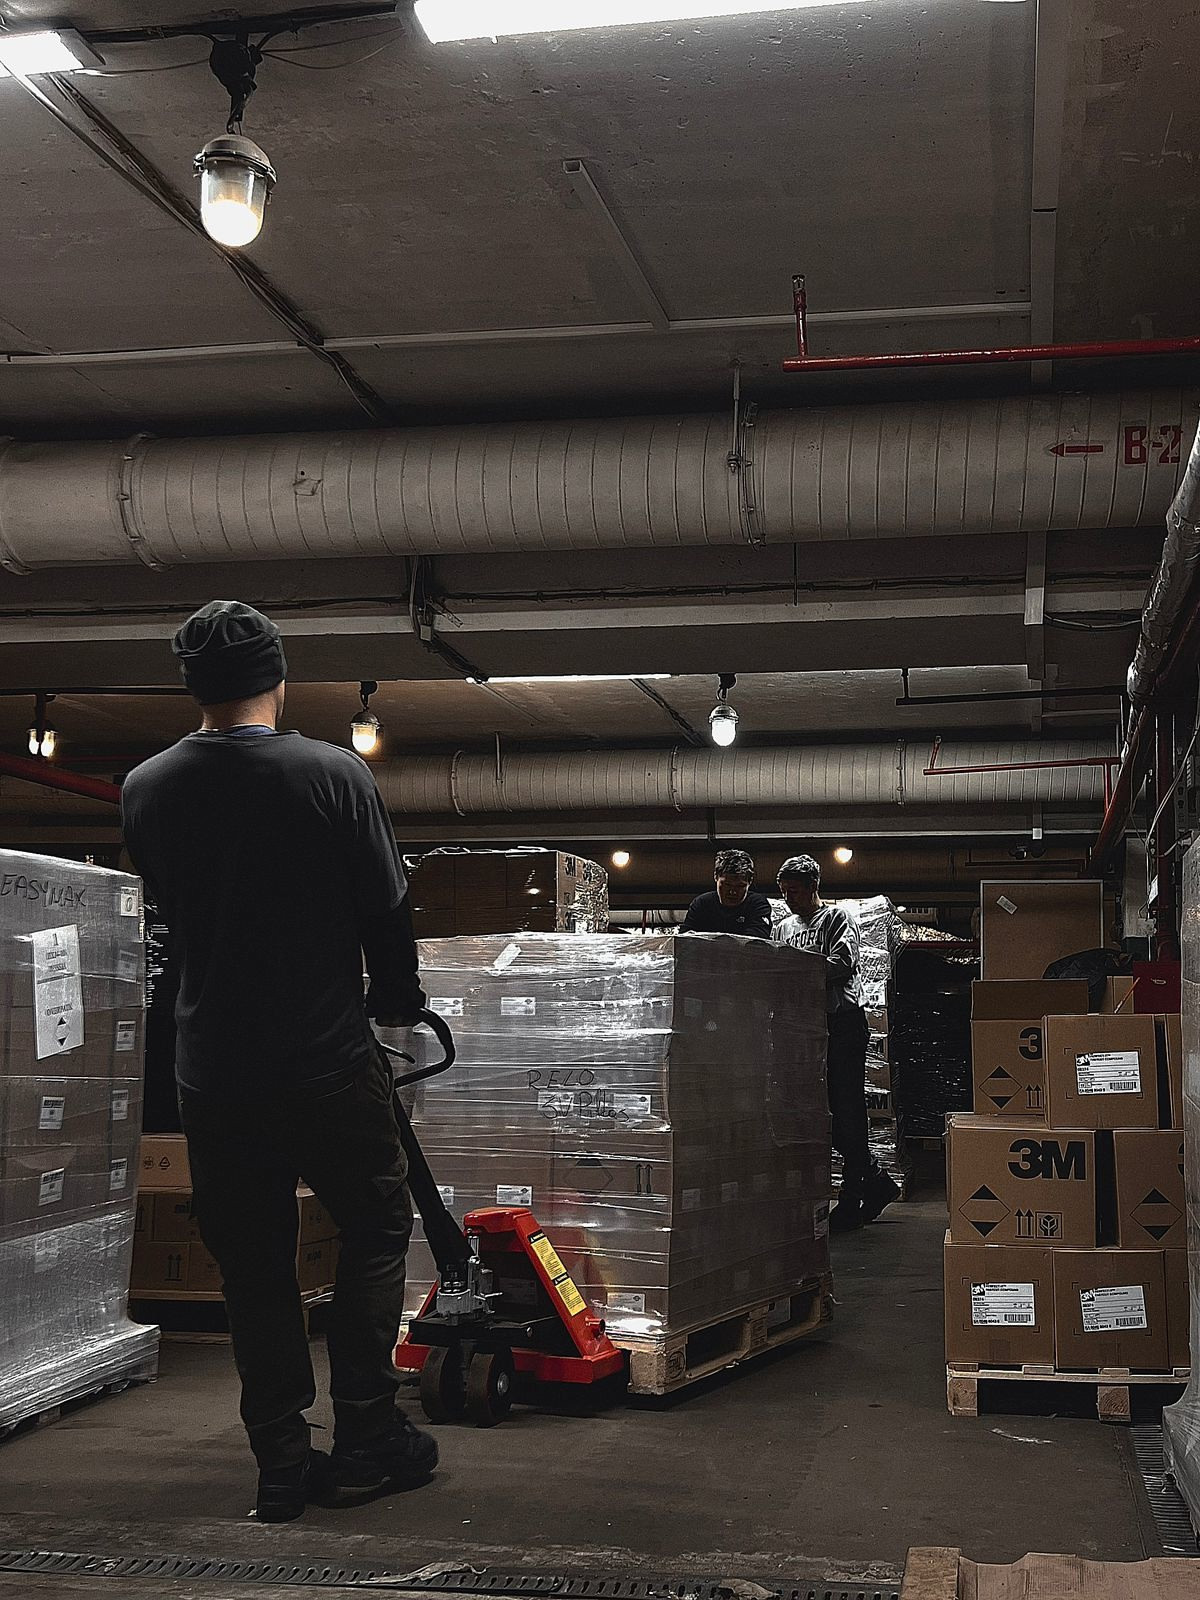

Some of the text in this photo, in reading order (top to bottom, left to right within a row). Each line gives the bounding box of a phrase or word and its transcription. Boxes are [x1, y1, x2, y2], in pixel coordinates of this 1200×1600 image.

[1125, 425, 1183, 464] B-2
[1019, 1027, 1042, 1061] 3
[526, 1069, 595, 1091] RELO
[1008, 1138, 1086, 1181] 3M
